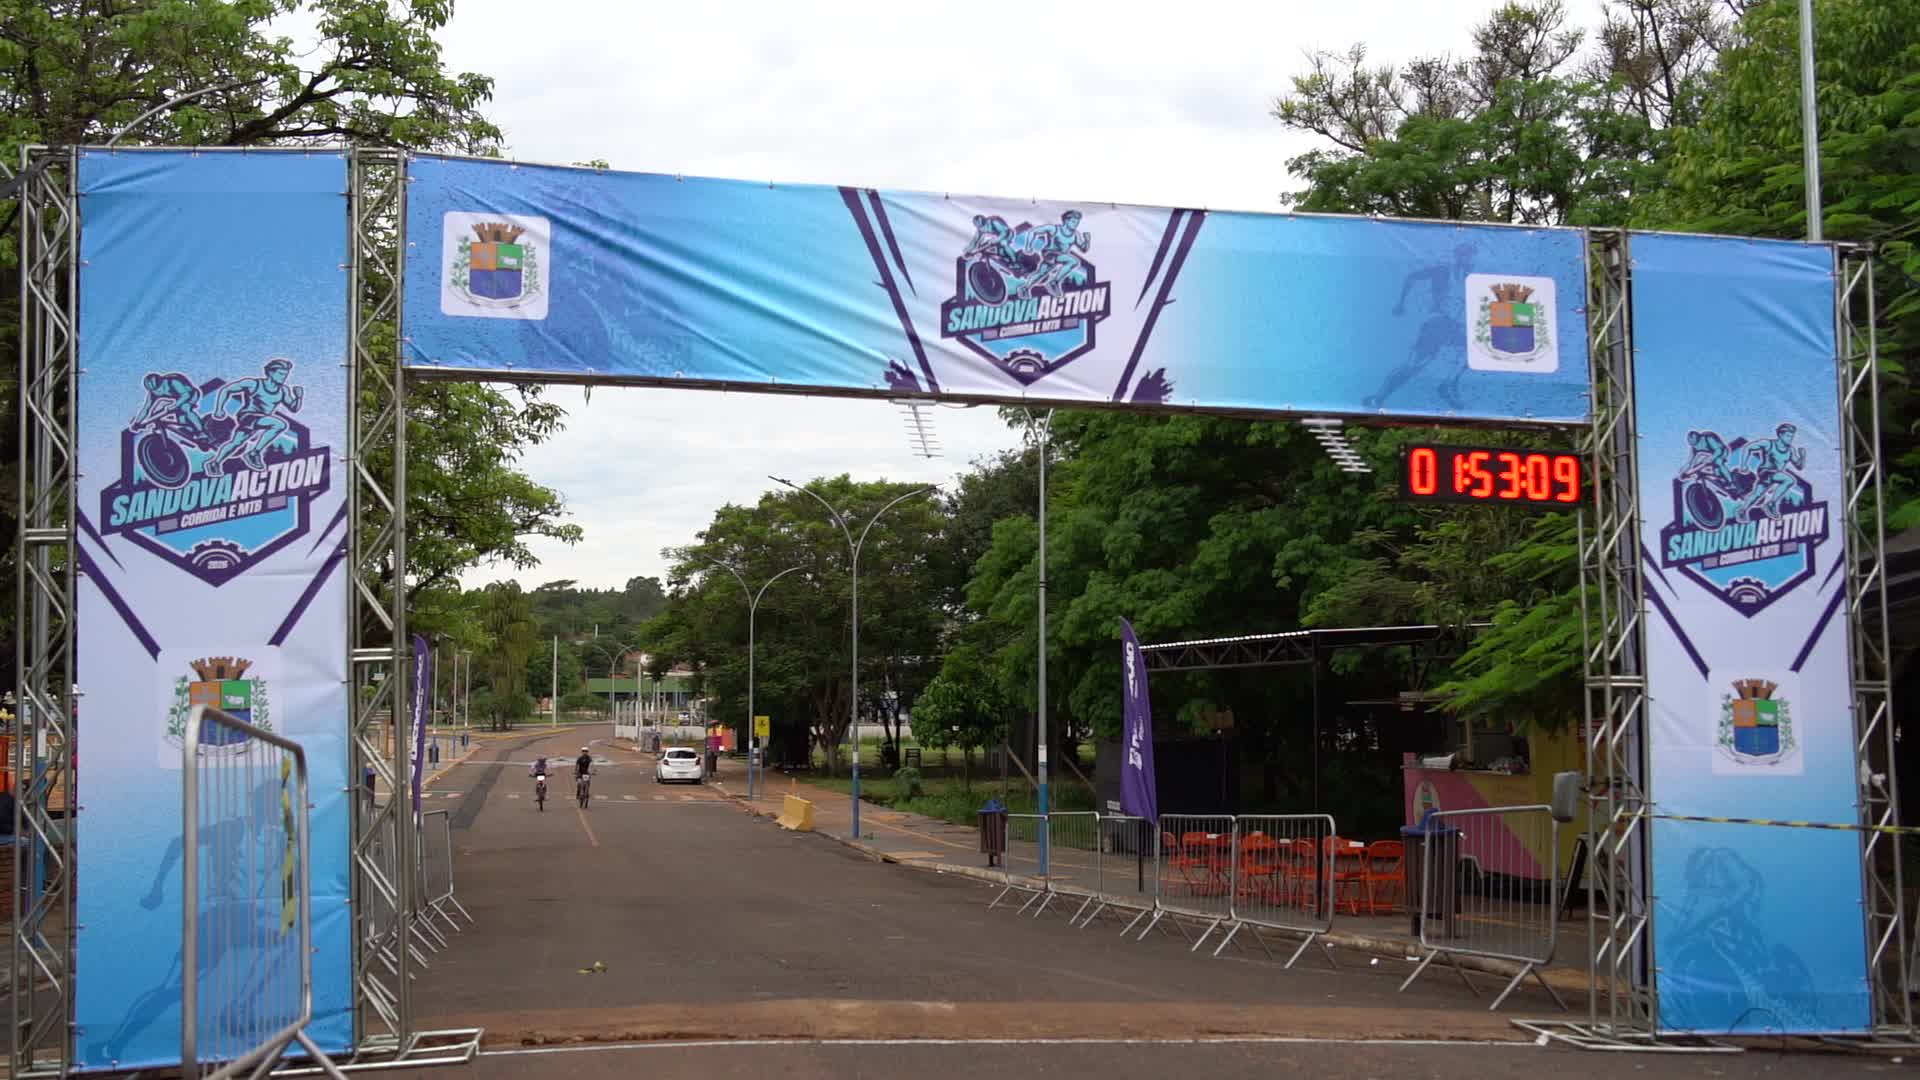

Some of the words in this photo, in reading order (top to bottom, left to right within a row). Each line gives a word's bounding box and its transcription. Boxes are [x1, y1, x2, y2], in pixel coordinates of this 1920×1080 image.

[180, 506, 227, 529] CORRIDA
[228, 503, 238, 518] E
[237, 499, 263, 516] MTB
